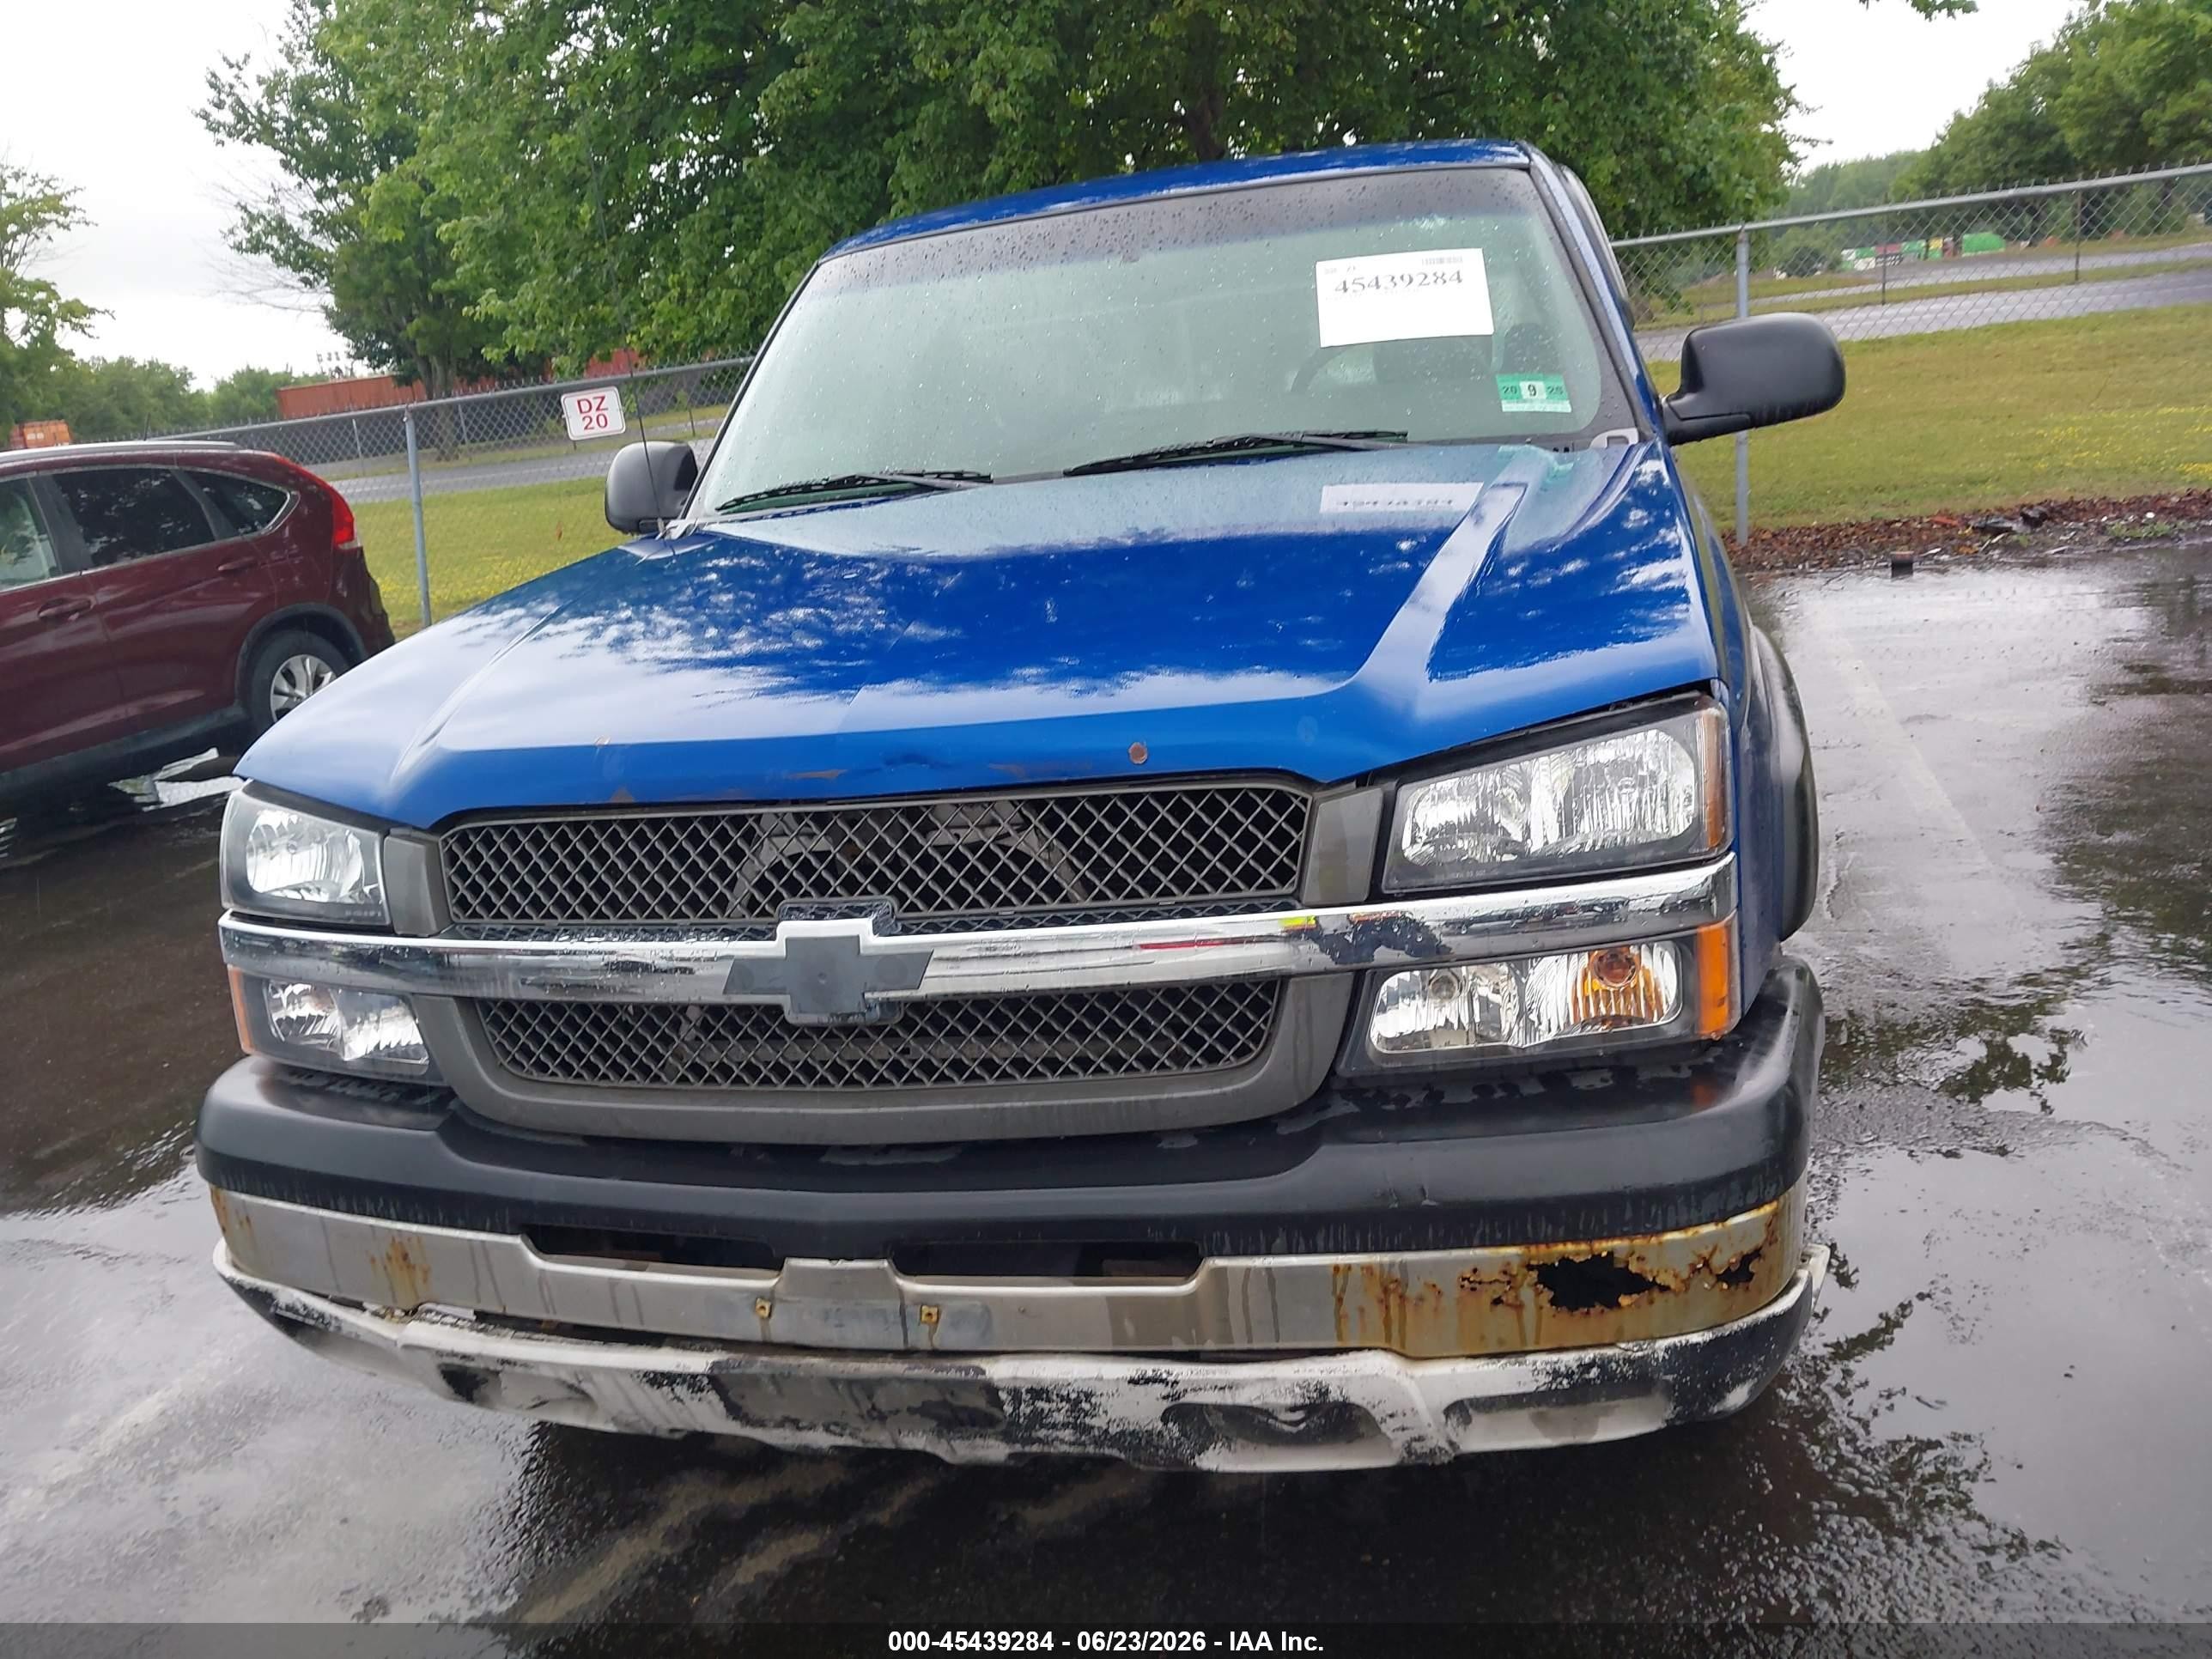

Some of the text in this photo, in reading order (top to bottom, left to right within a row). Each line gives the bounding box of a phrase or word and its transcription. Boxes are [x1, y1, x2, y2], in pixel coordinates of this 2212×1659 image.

[1334, 268, 1463, 295] 45439284
[1528, 384, 1537, 397] 9
[576, 395, 609, 414] DZ
[581, 413, 608, 430] 20
